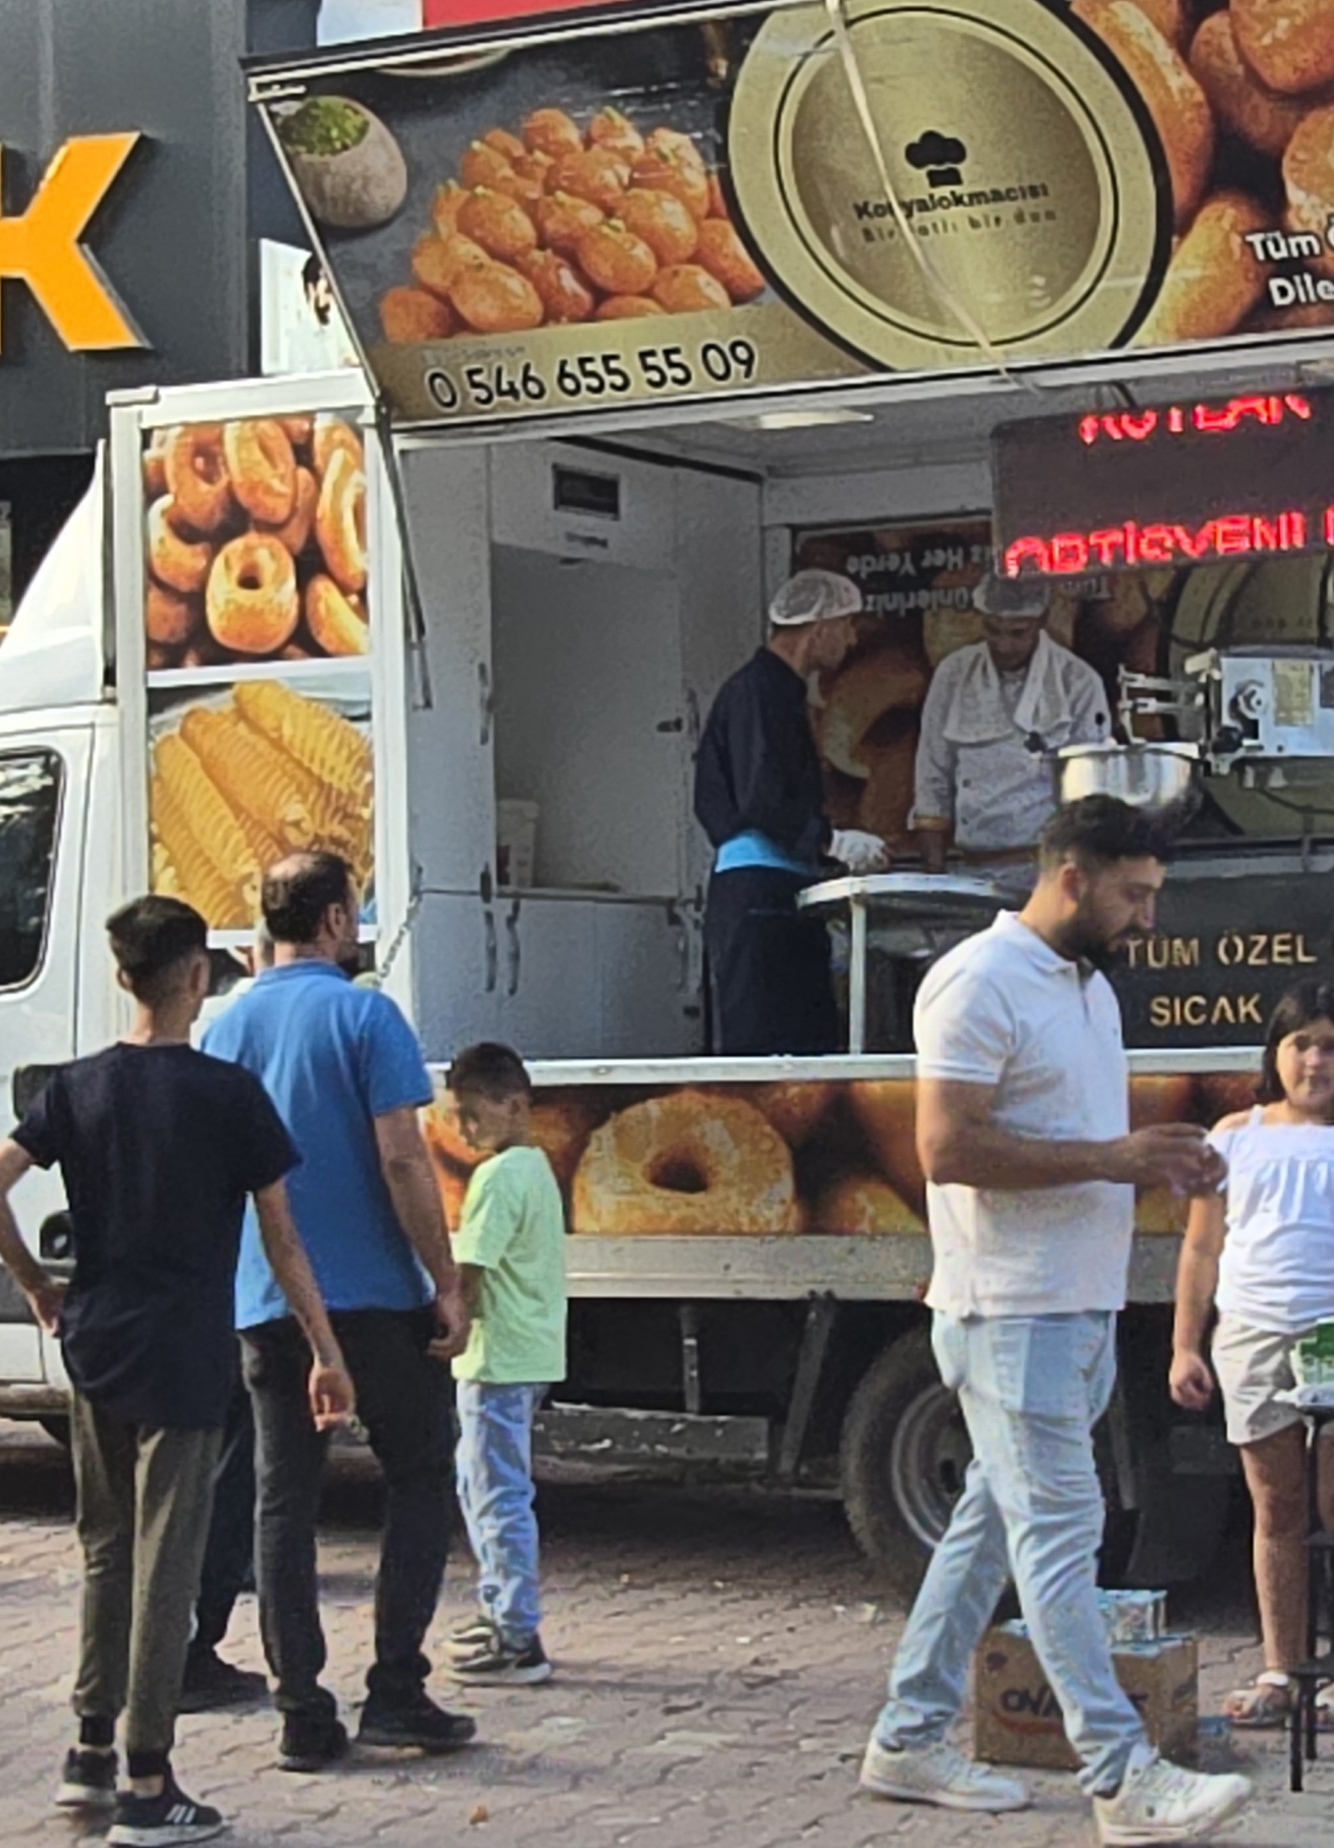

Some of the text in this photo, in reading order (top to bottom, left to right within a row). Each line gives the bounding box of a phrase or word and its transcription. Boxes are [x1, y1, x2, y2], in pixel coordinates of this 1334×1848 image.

[1246, 231, 1320, 262] Tüm
[426, 371, 458, 409] 0
[464, 361, 547, 406] 546
[557, 353, 631, 398] 655
[638, 346, 693, 389] 55
[700, 339, 756, 383] 09
[1125, 927, 1200, 968] TÜM
[1217, 928, 1318, 966] ÖZEL
[1149, 992, 1263, 1027] SICAK
